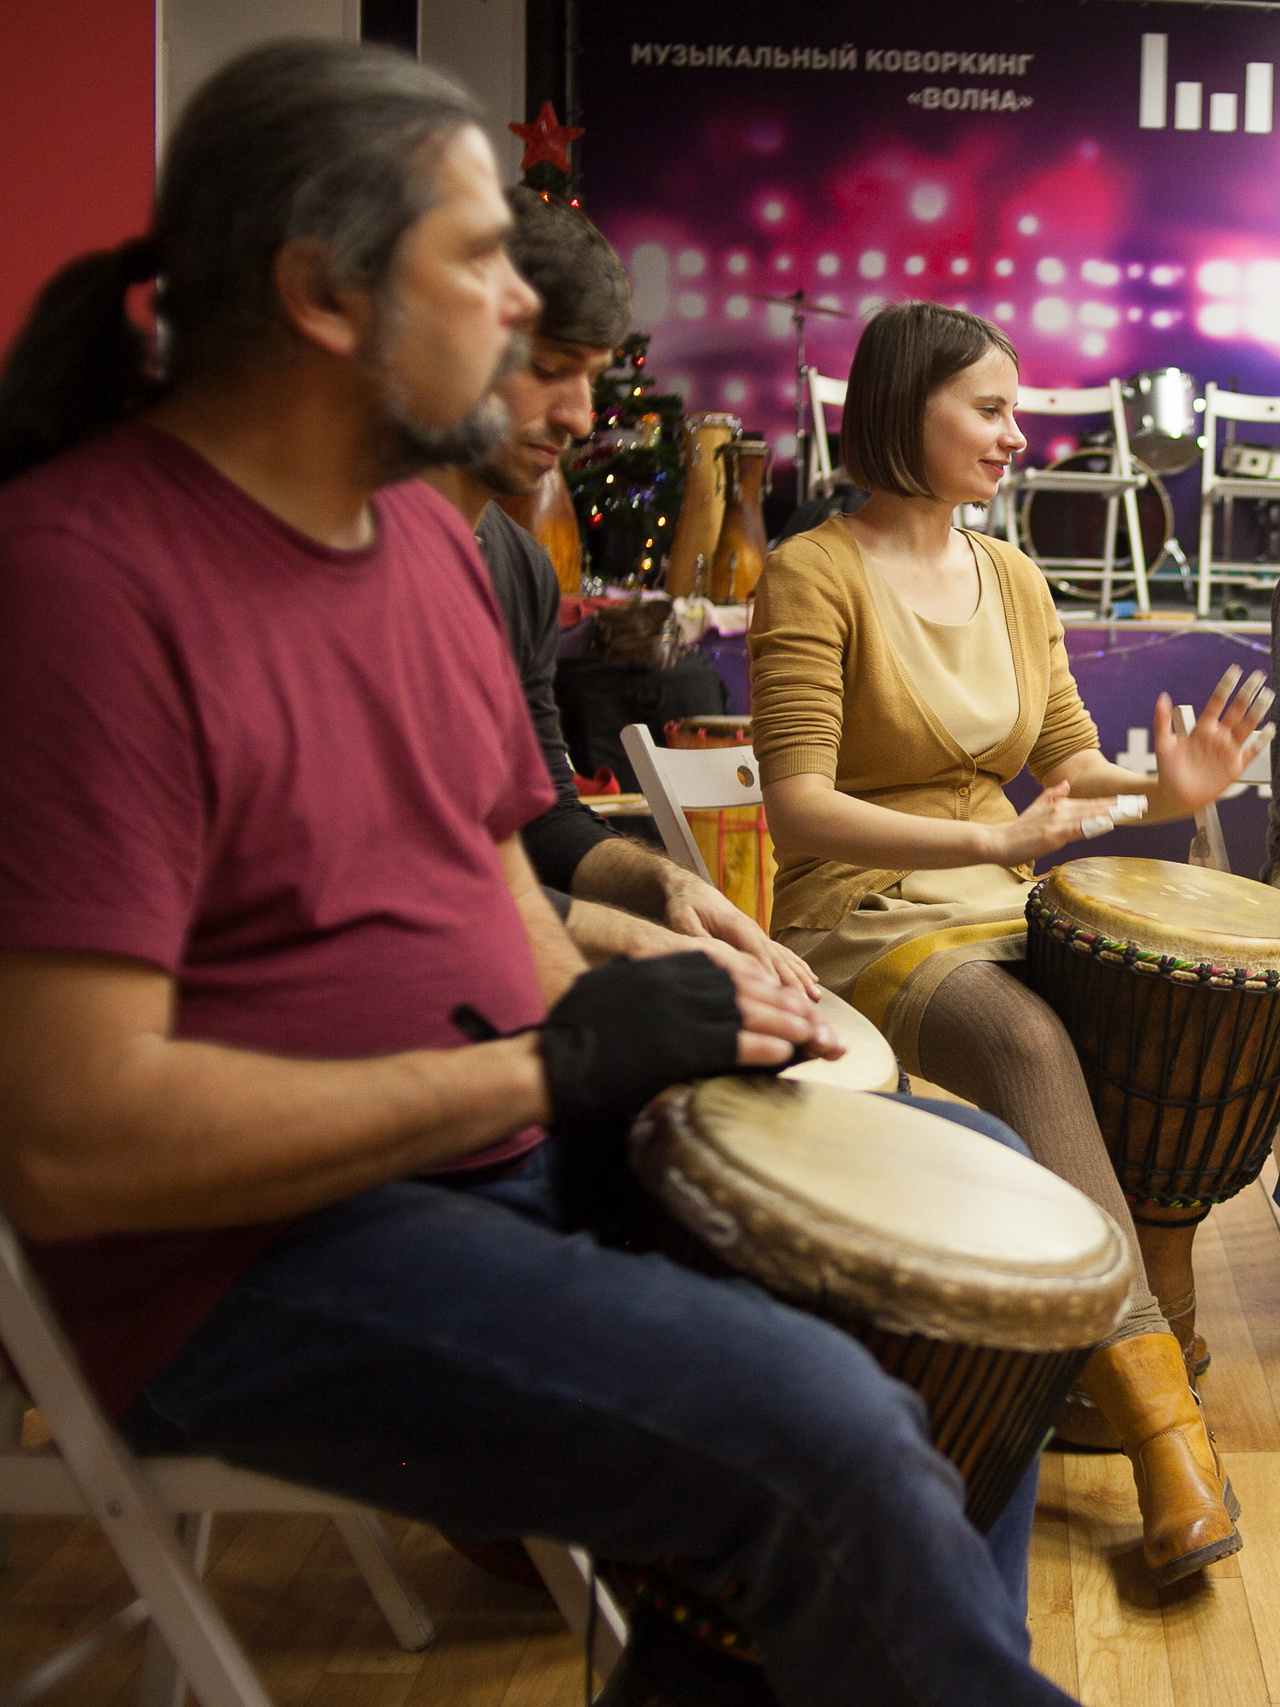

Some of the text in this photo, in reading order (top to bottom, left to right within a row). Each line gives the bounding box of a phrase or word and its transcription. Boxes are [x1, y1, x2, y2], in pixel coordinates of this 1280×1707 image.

[630, 43, 1034, 76] МУЗЫКАЛЬНЫЙ КОВОРКИНГ
[907, 87, 1034, 112] «ВОЛНА»
